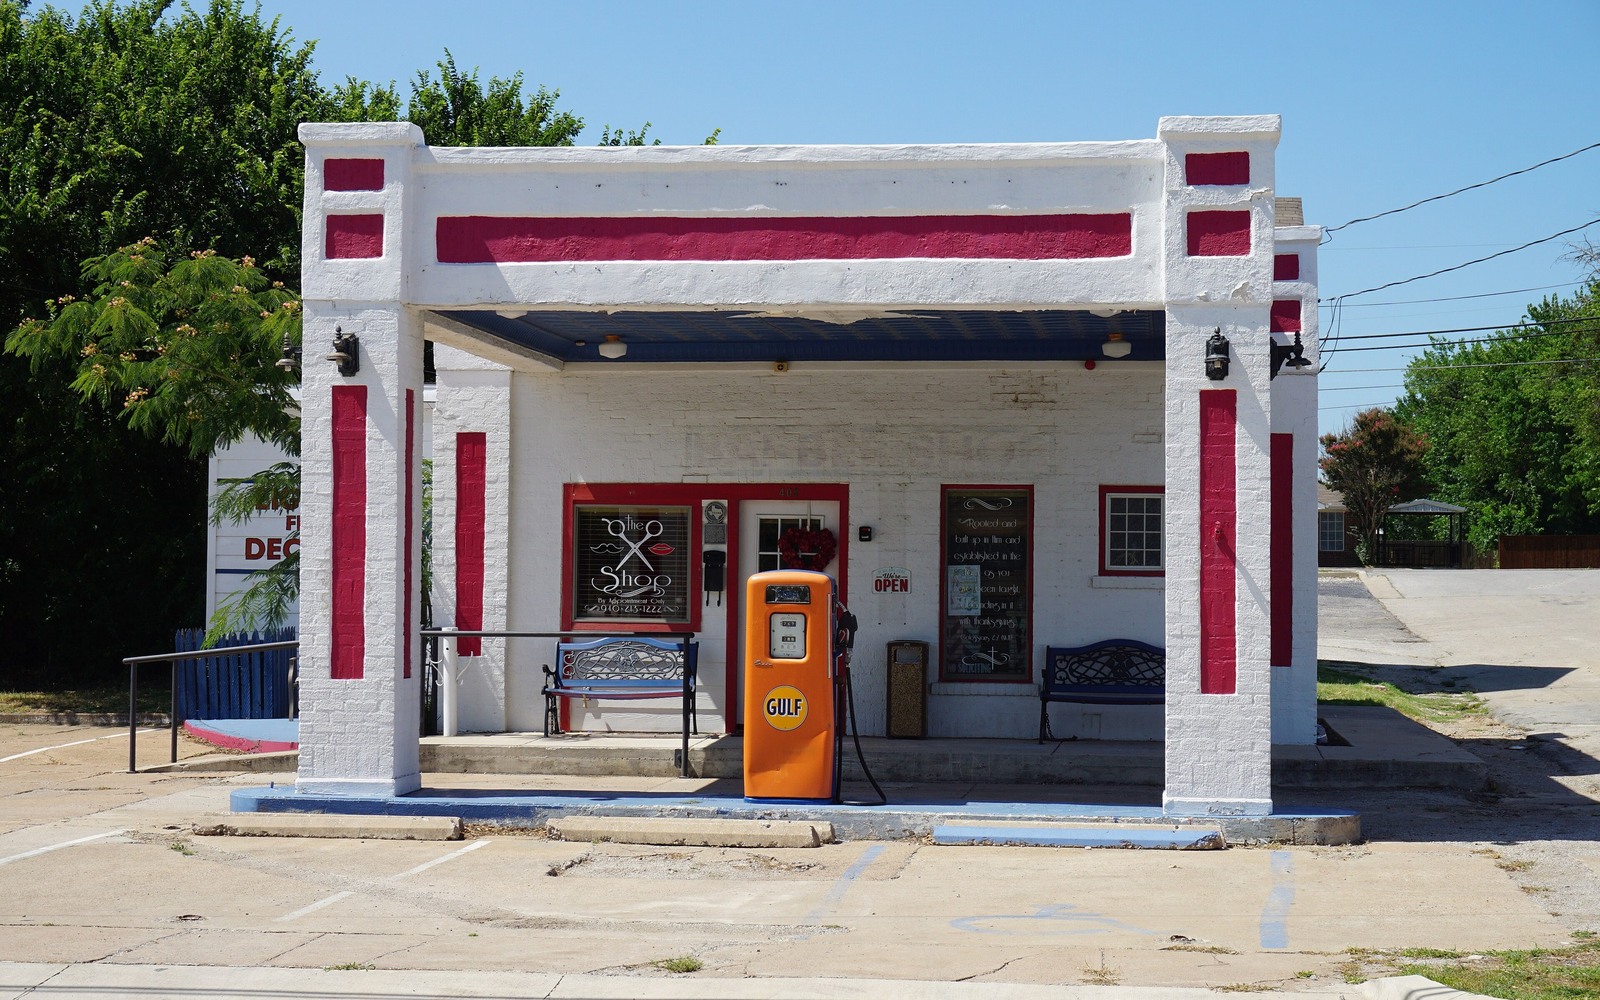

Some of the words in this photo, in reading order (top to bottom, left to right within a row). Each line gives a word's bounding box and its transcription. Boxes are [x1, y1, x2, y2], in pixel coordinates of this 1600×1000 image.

[625, 514, 645, 531] The
[959, 518, 999, 529] Rooted
[1001, 519, 1017, 528] and
[1005, 535, 1021, 544] and
[1010, 552, 1021, 560] the
[591, 566, 672, 596] Shop
[874, 578, 908, 592] OPEN
[608, 597, 648, 605] Appointment
[766, 698, 803, 717] GULF
